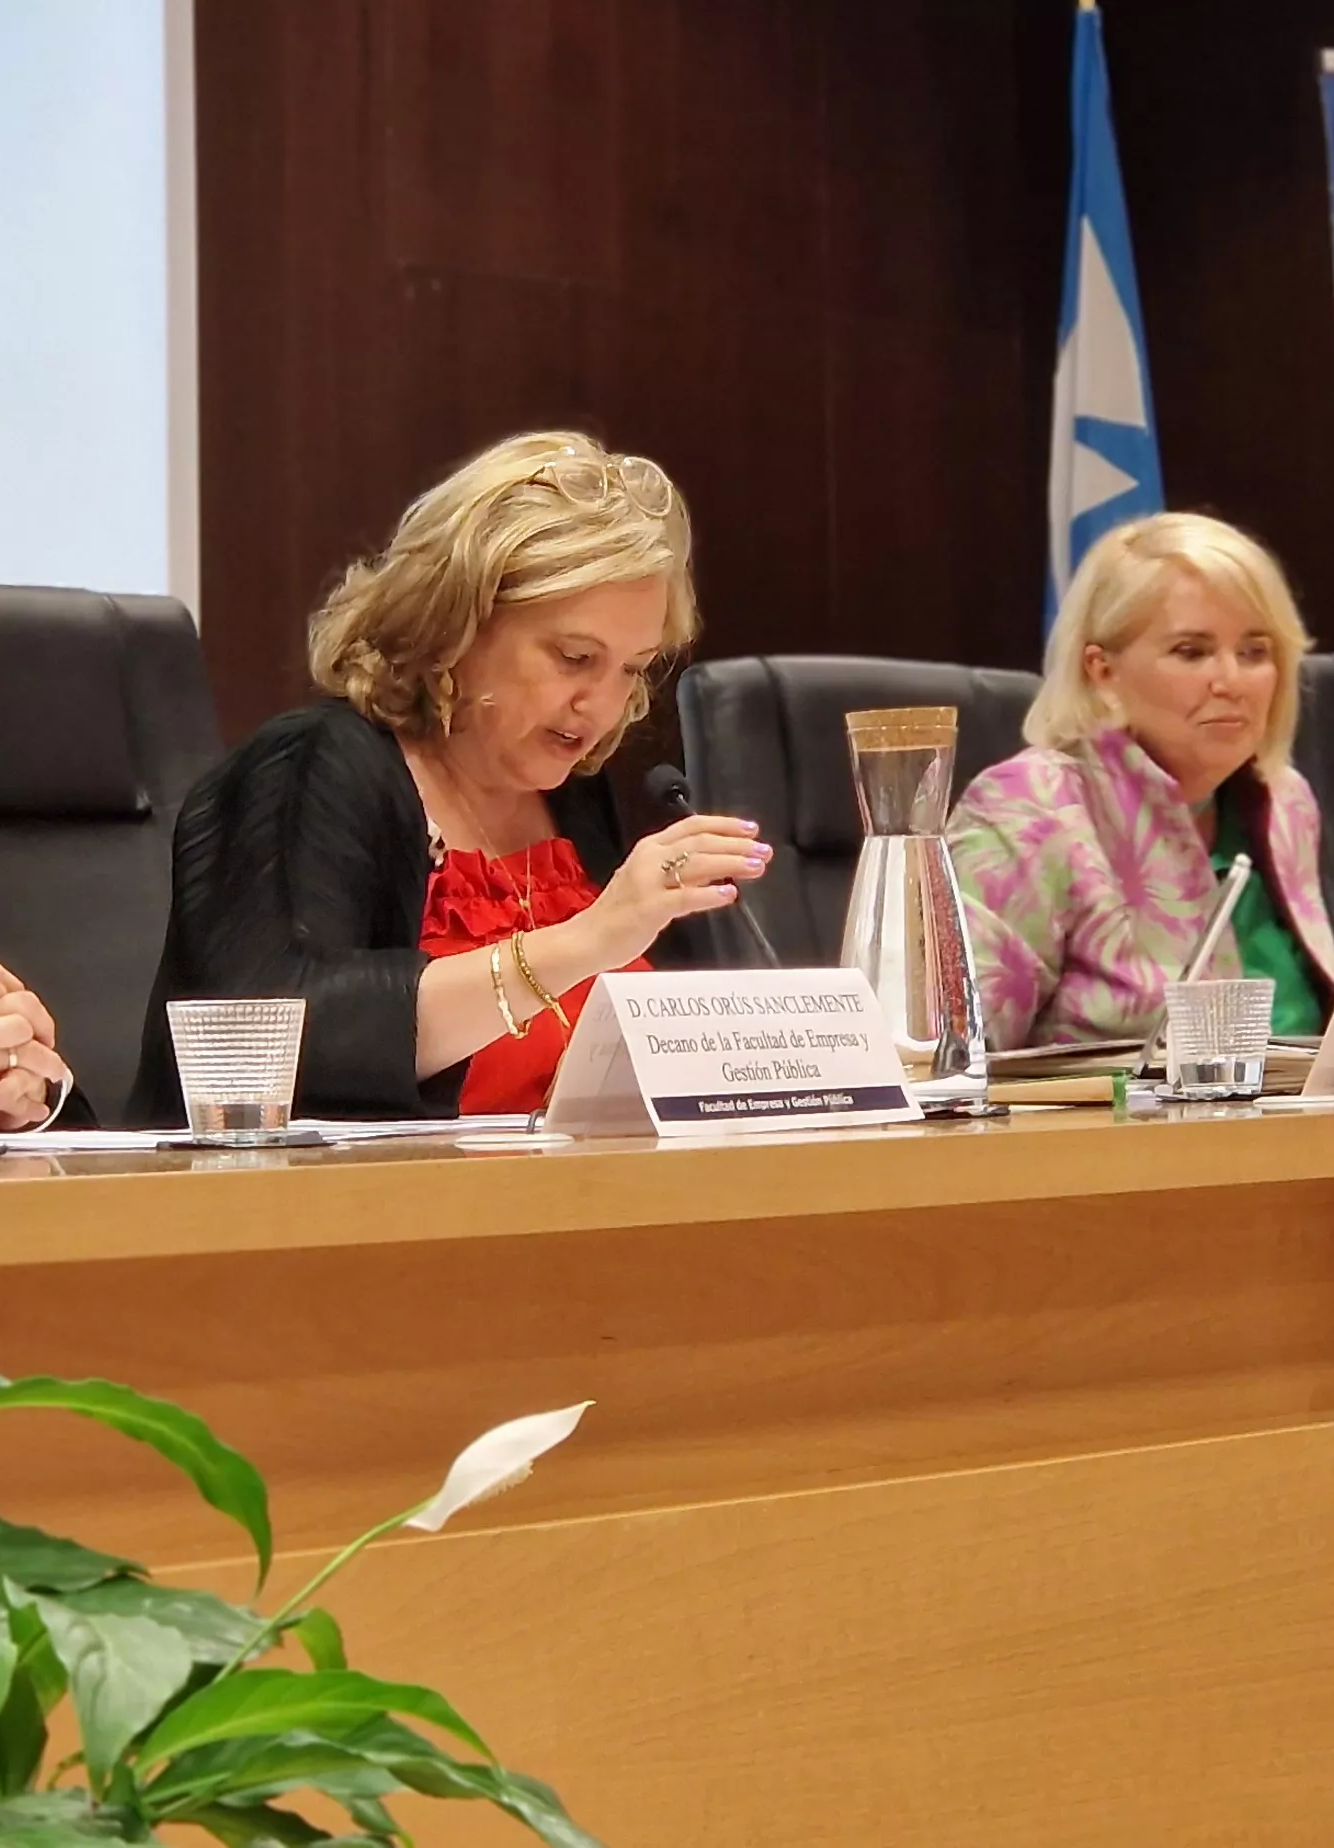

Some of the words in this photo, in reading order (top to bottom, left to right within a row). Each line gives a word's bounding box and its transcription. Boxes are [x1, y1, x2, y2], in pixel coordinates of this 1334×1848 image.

[626, 998, 647, 1019] D.
[647, 997, 711, 1018] CARLOS
[712, 990, 755, 1016] ORÚS
[753, 993, 865, 1015] SANCLEMENTE
[646, 1034, 699, 1055] Decano
[701, 1032, 716, 1052] de
[718, 1031, 732, 1051] la
[732, 1029, 790, 1051] Facultad
[790, 1030, 806, 1049] de
[808, 1029, 858, 1053] Empresa
[860, 1033, 870, 1052] y
[721, 1060, 770, 1083] Gestión
[771, 1057, 822, 1082] Pública
[698, 1099, 735, 1114] Facultad
[736, 1099, 748, 1112] de
[749, 1098, 784, 1112] Empresa
[784, 1098, 792, 1110] y
[792, 1094, 823, 1109] Gestión
[823, 1092, 854, 1107] Pública
